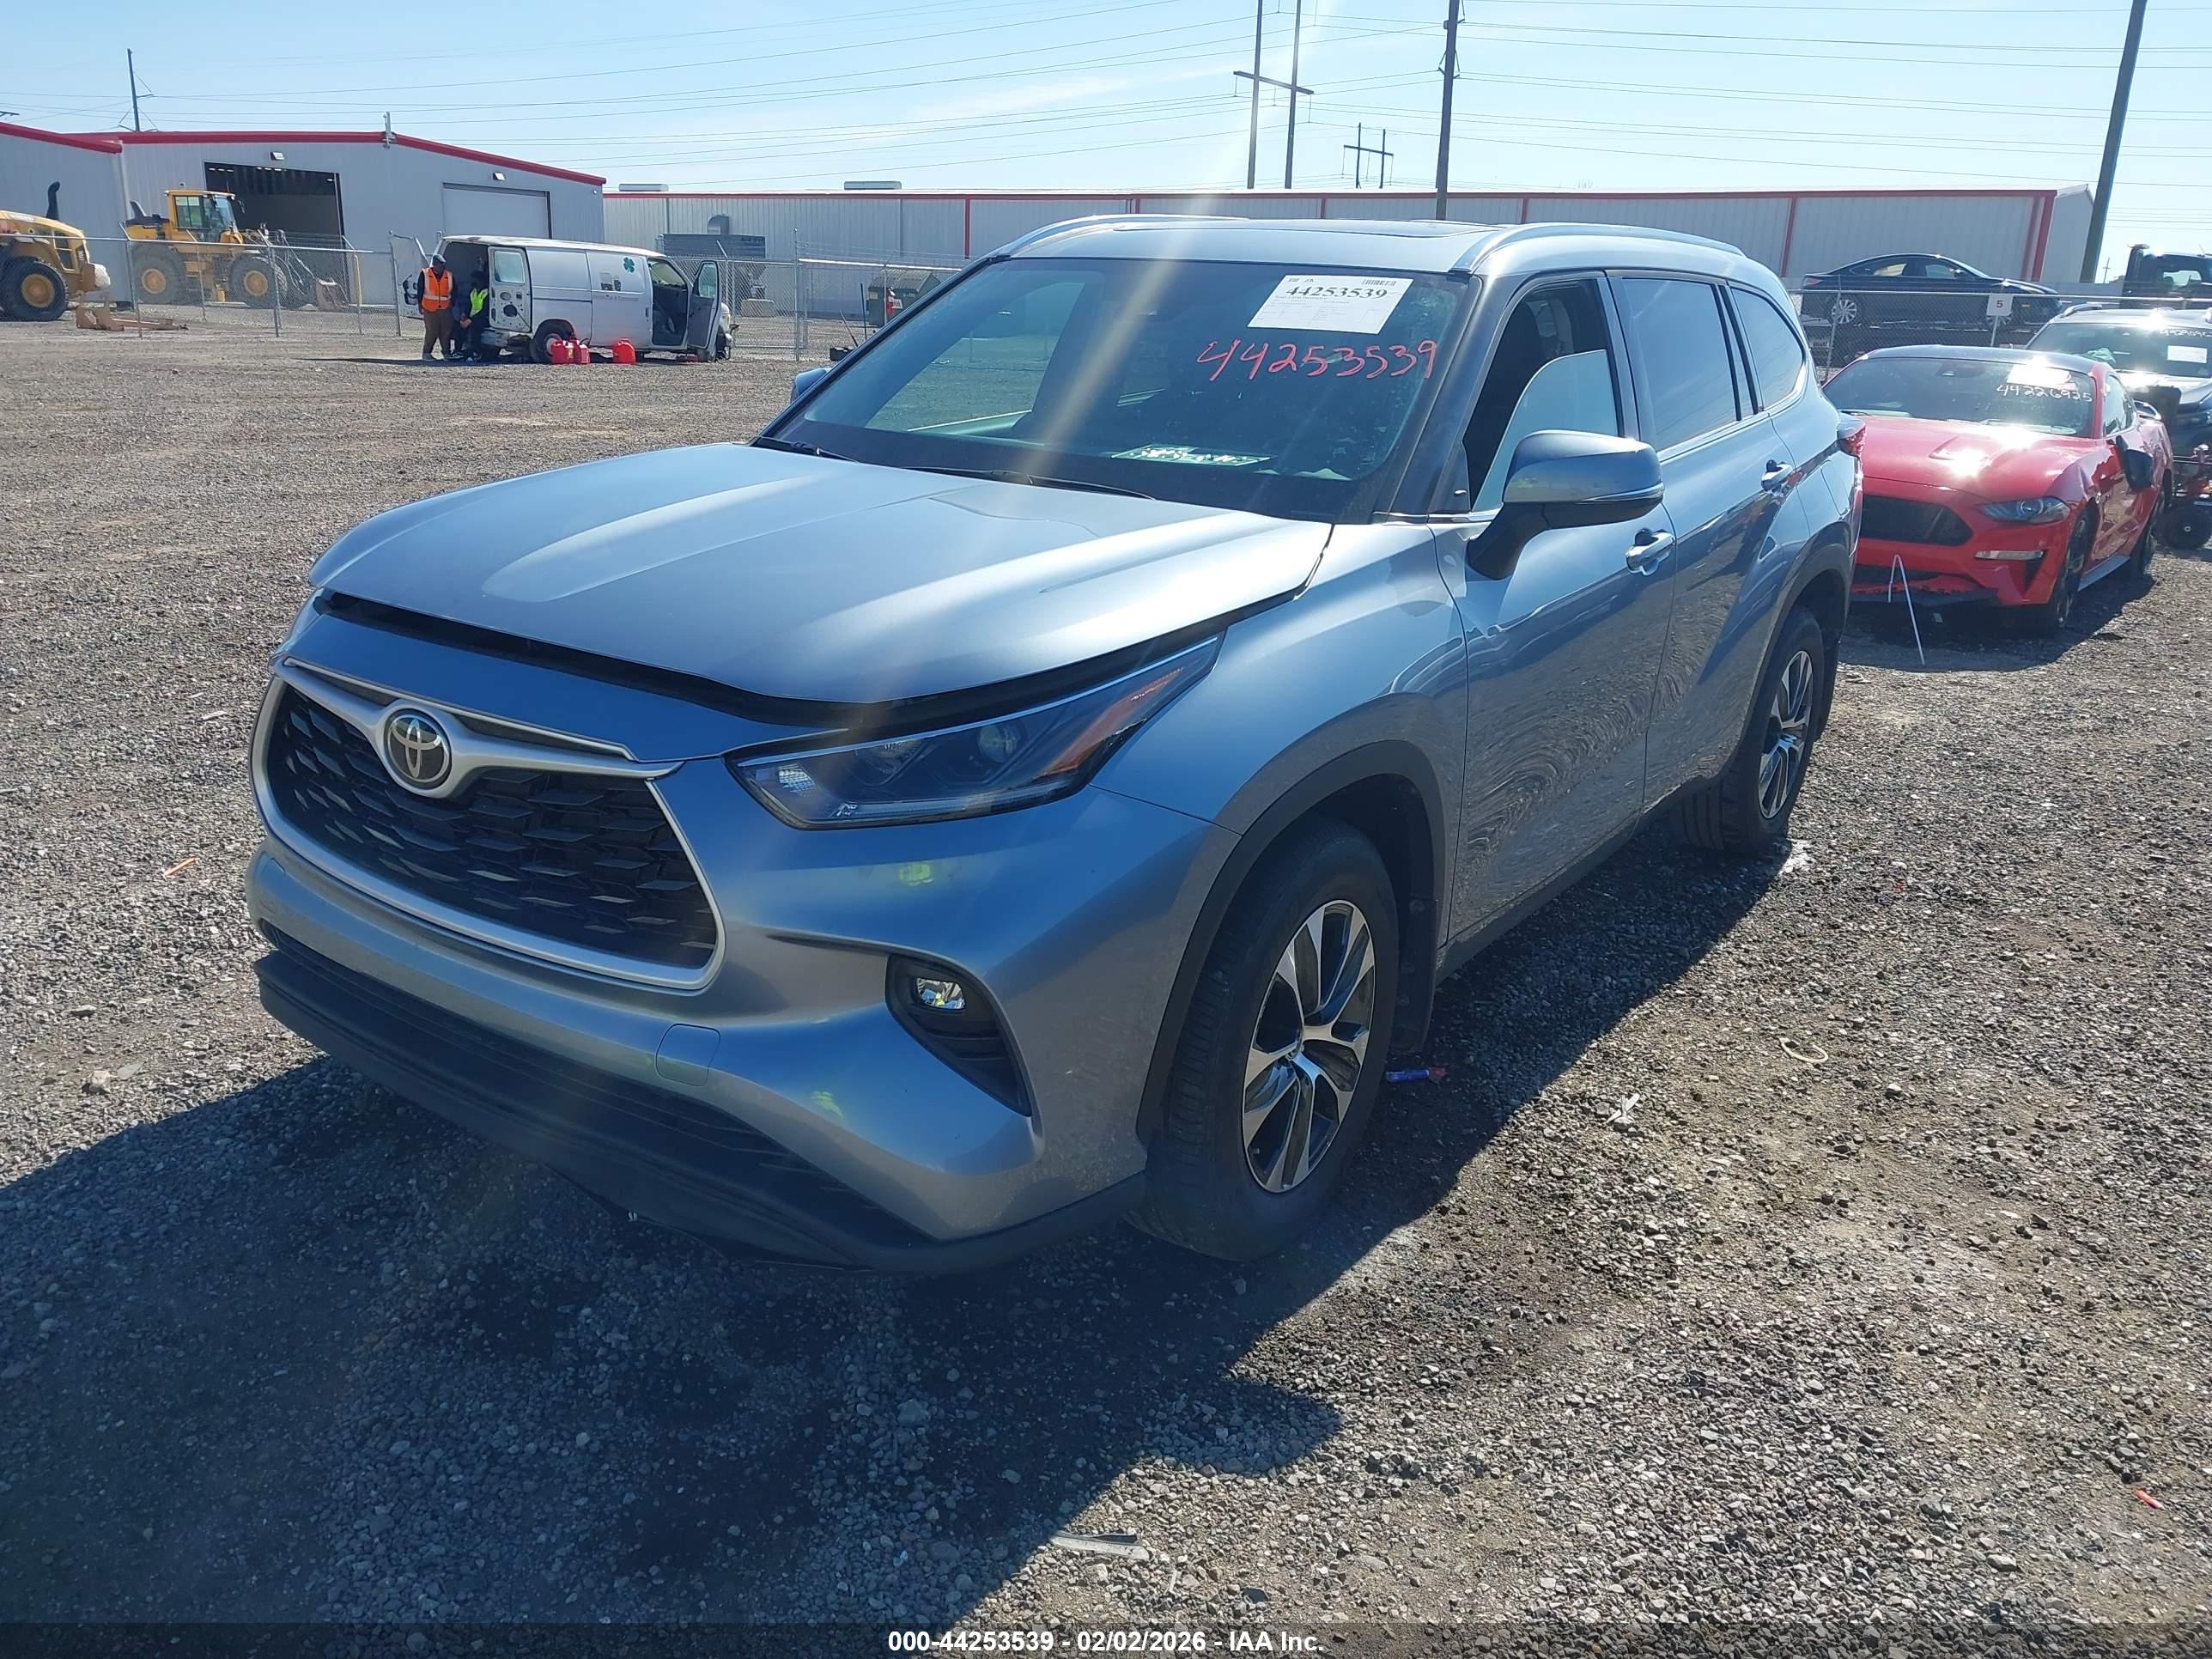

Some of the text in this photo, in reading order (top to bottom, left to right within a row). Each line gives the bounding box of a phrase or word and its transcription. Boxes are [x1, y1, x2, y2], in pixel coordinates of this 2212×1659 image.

[1285, 285, 1388, 299] 44253539
[1996, 300, 2005, 308] 5
[1196, 338, 1438, 381] 44253539
